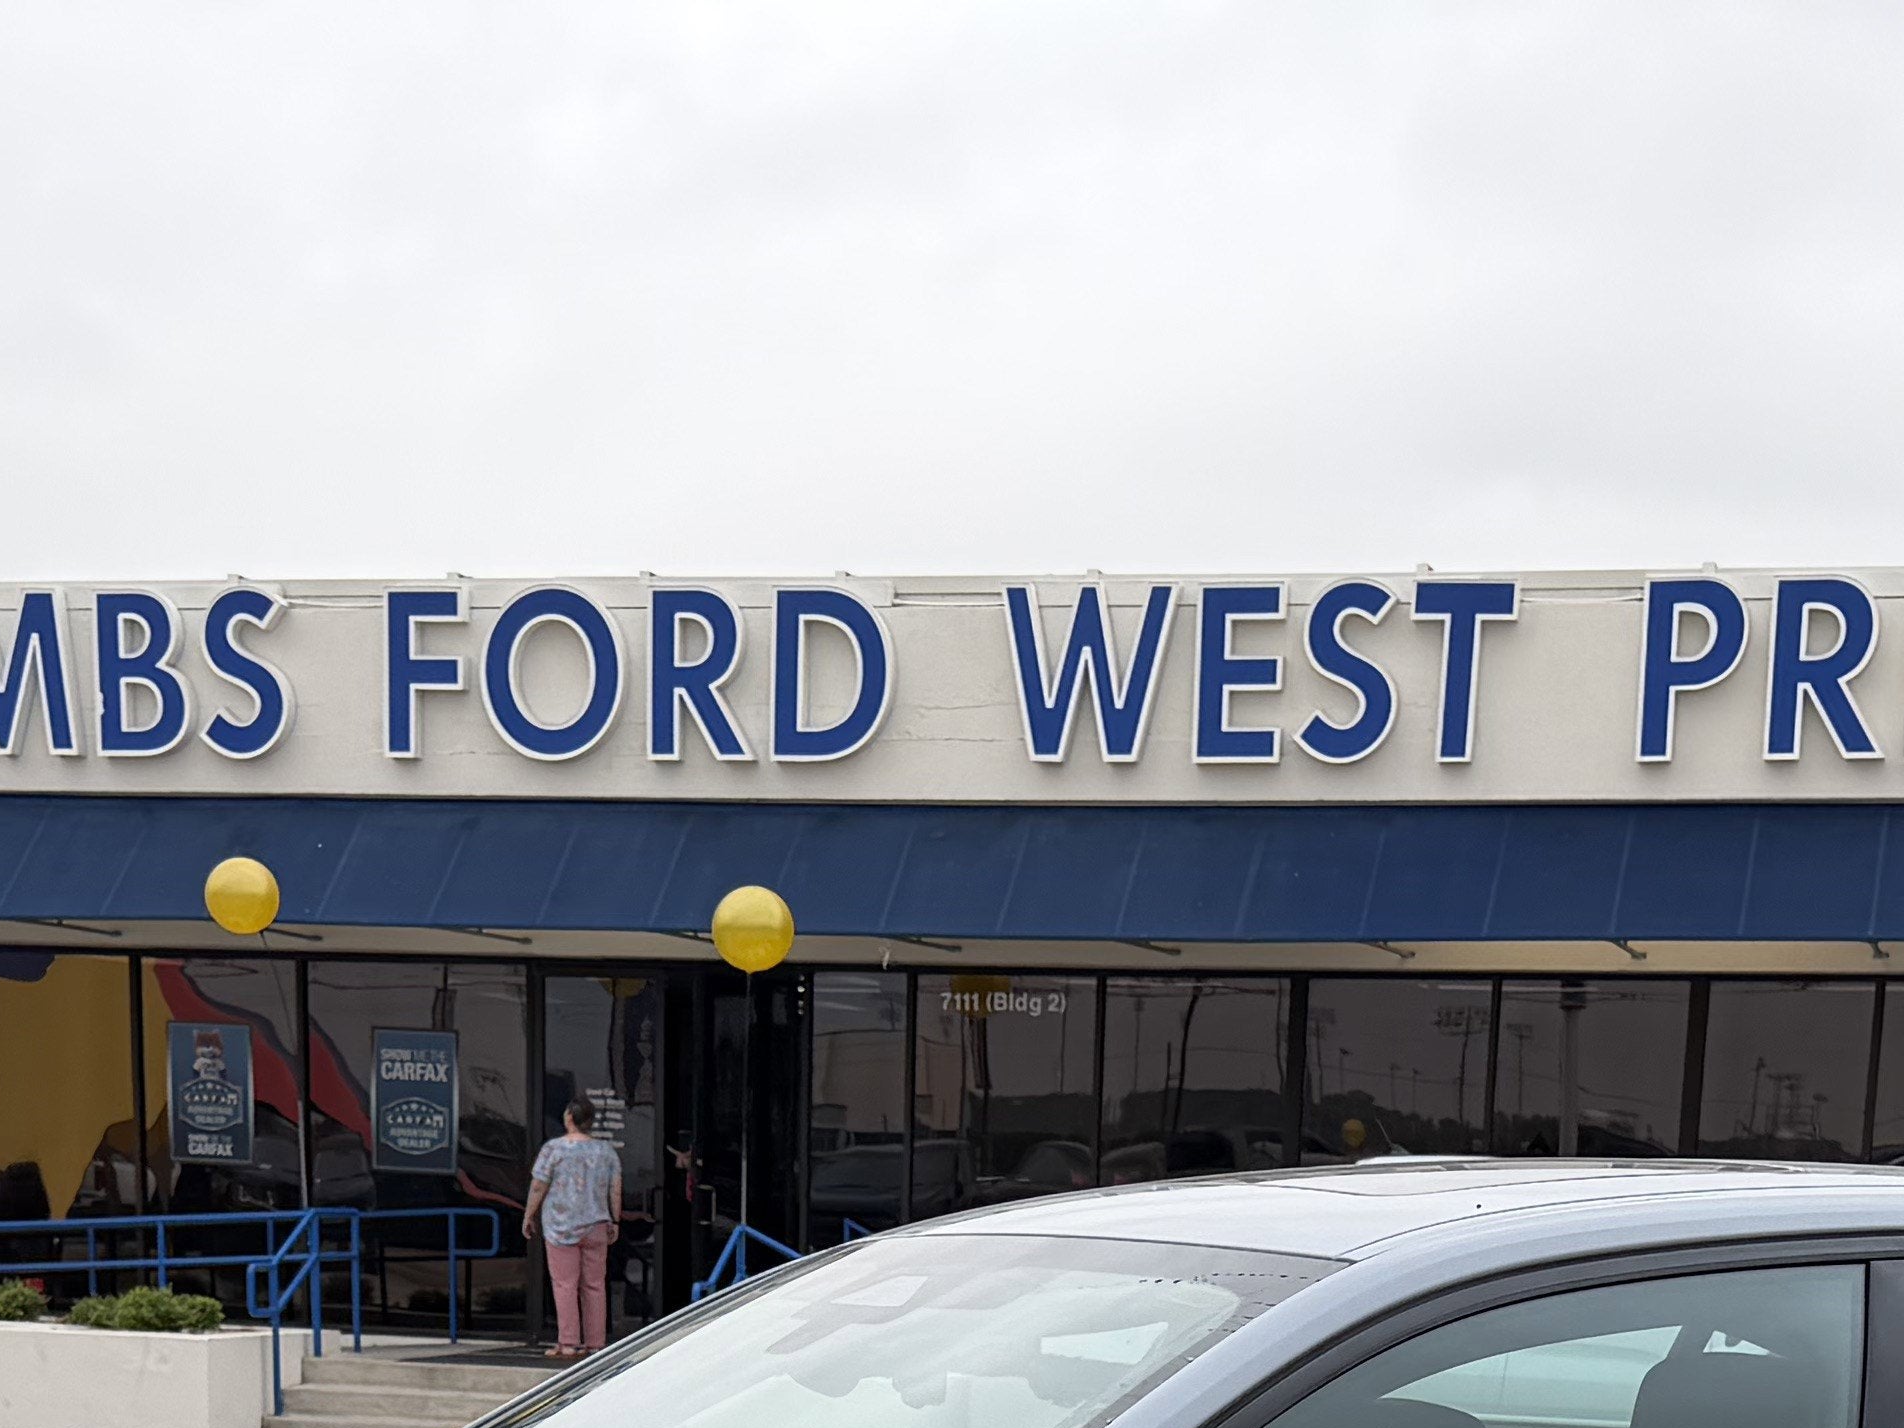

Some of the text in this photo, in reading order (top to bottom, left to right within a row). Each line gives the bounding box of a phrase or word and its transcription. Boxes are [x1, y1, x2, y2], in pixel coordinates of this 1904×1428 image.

[382, 583, 897, 762] FORD
[1002, 580, 1520, 765] WEST
[940, 991, 1066, 1017] 7111 (Bldg 2)
[381, 1060, 448, 1083] CARFAX
